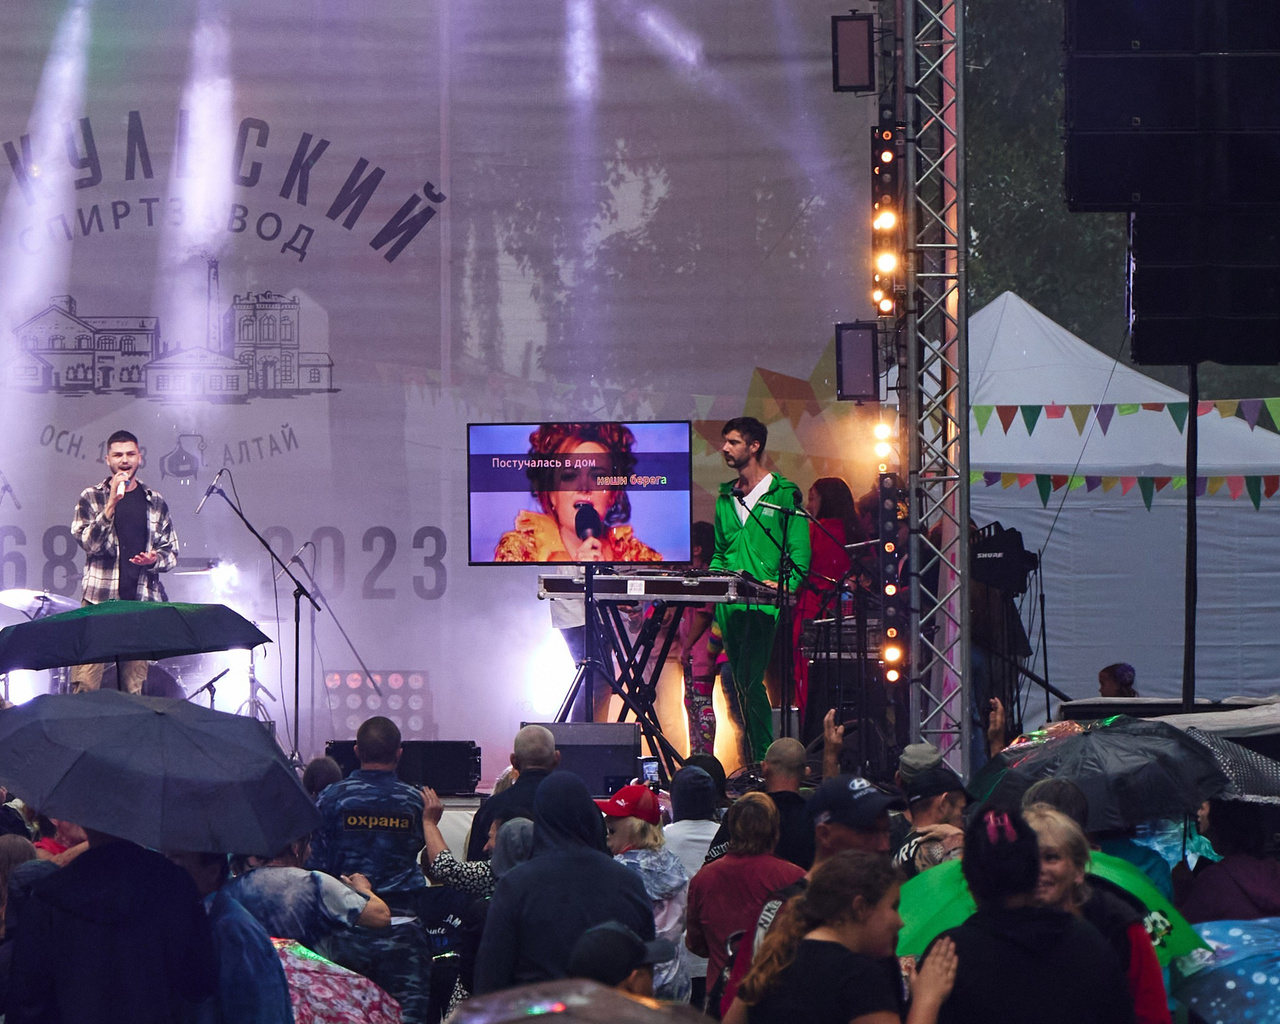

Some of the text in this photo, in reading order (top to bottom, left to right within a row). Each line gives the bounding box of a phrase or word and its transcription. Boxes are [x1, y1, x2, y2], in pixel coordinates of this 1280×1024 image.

[20, 197, 315, 262] СПИРТЗВОД
[39, 424, 86, 461] ОСН.
[222, 422, 300, 467] АЛТАЙ
[491, 457, 596, 470] Постучалась в дом
[596, 474, 667, 487] наши берега
[260, 525, 448, 600] 2023
[346, 815, 410, 829] охрана
